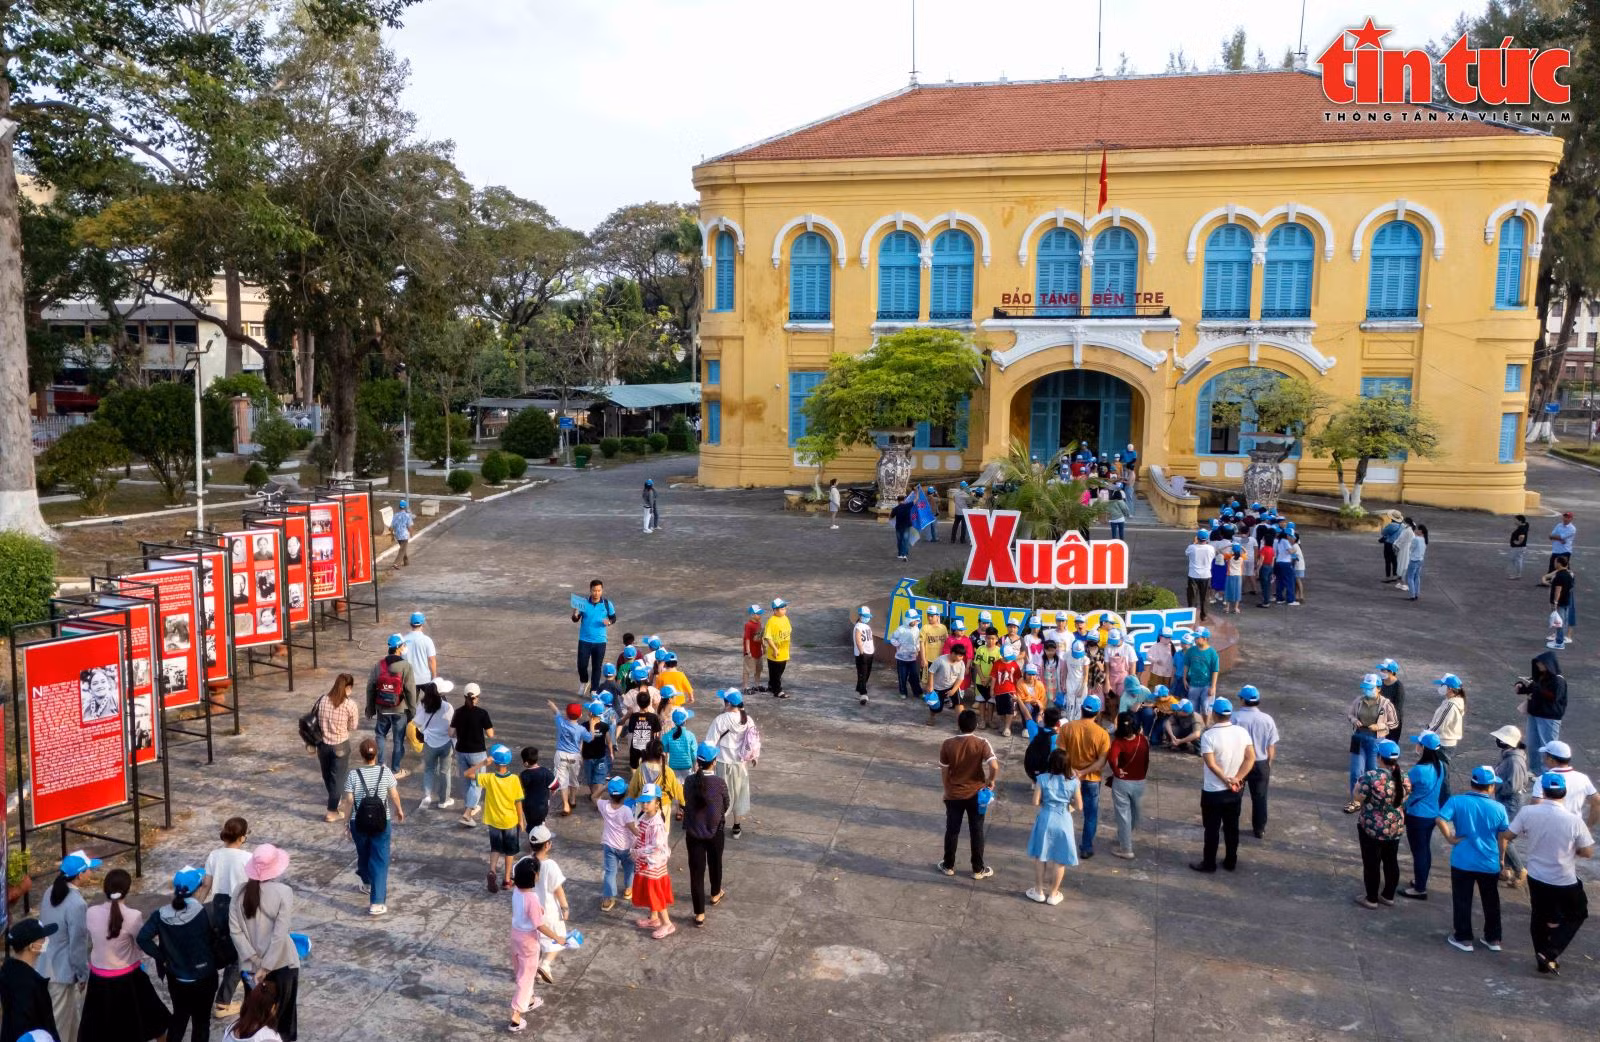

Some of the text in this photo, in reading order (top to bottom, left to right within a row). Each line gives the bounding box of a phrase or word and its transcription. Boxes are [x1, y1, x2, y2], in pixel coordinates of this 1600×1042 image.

[1001, 287, 1032, 304] BẢO
[1092, 282, 1124, 304] BẾN
[1134, 291, 1164, 304] TRE
[964, 510, 1127, 588] Xuân
